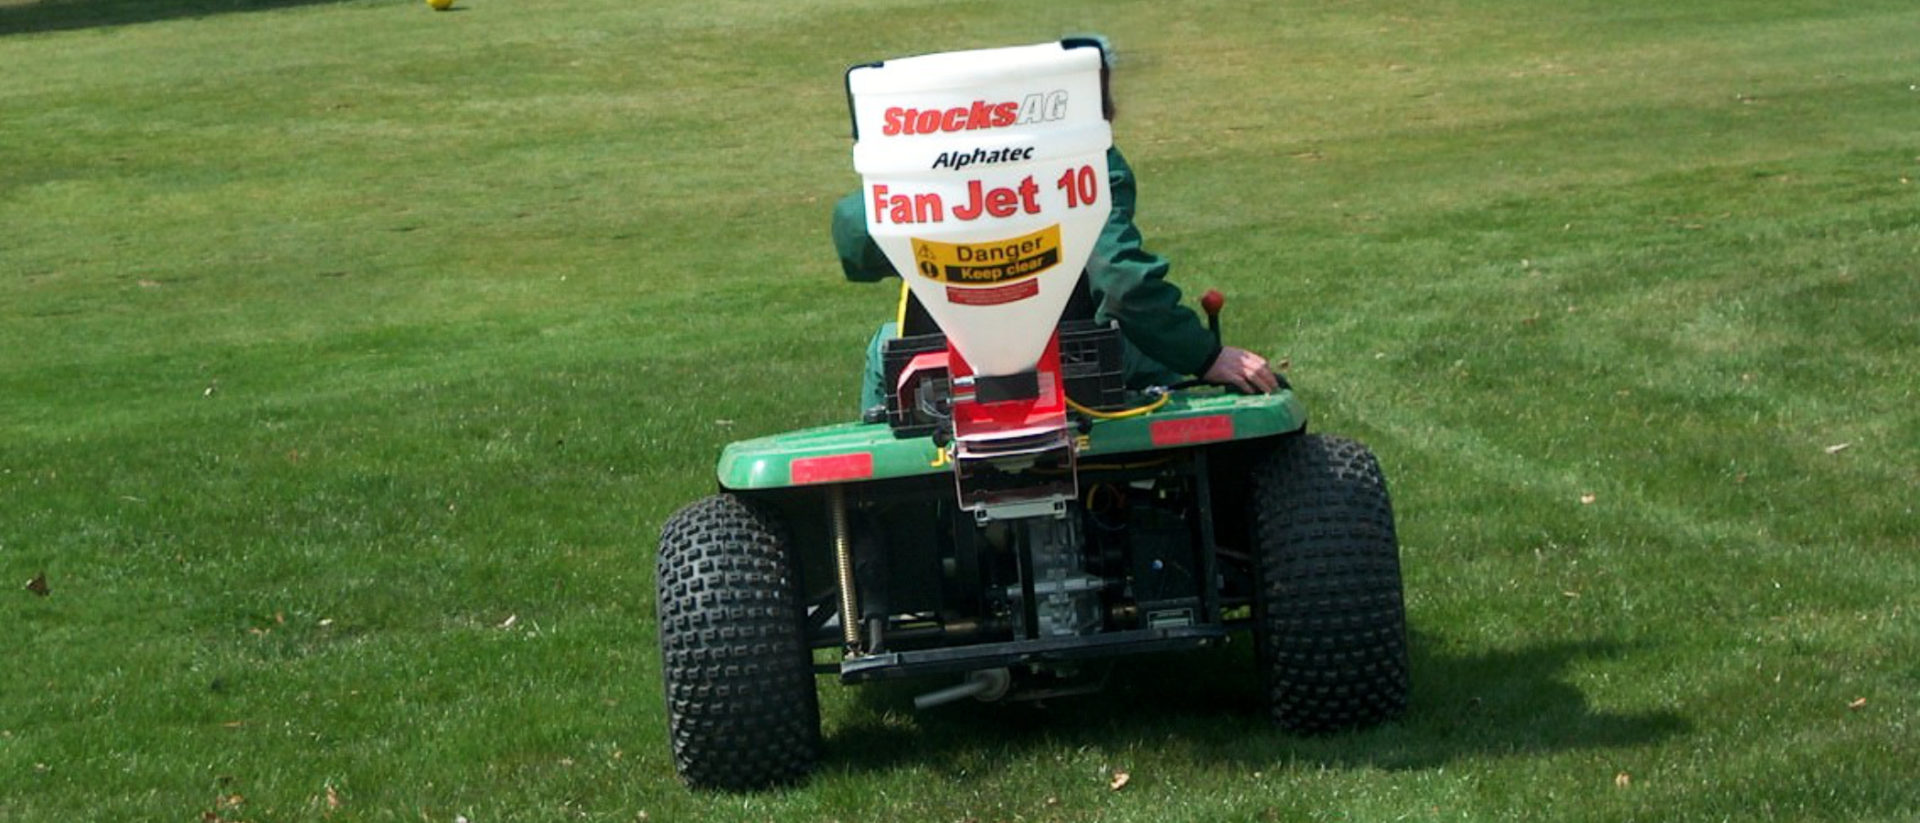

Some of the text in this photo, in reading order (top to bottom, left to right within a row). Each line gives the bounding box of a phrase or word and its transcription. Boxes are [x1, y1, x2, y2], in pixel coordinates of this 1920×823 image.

[932, 146, 1035, 170] Alphatec
[872, 164, 1098, 224] Fan Jet 10
[956, 236, 1043, 262] Danger
[960, 256, 1044, 281] Keep clear
